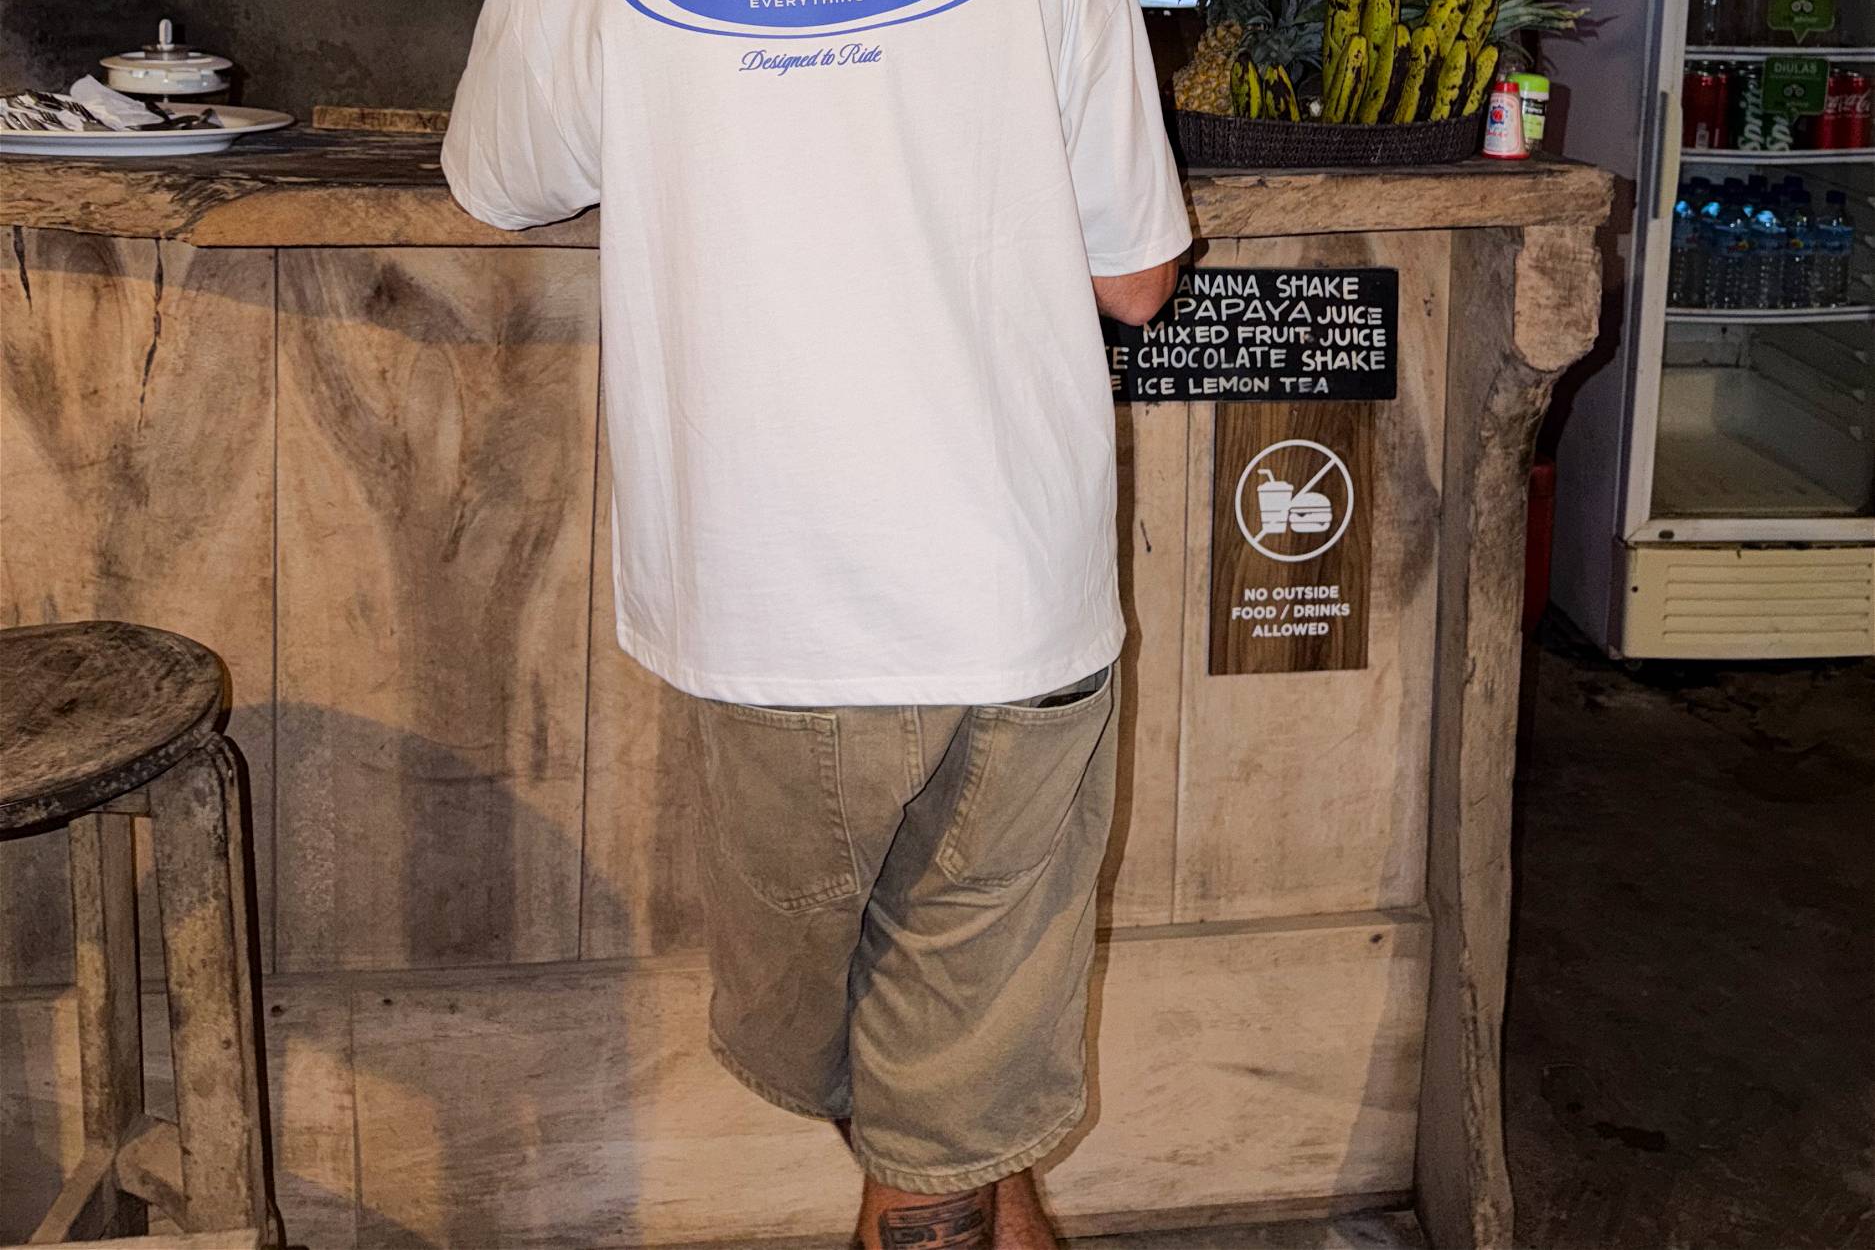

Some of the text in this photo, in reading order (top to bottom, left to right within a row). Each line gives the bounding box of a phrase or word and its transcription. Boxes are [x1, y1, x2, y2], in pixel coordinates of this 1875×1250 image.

[739, 43, 882, 77] Designed to Ride
[1177, 274, 1360, 300] ANANA SHAKE
[1173, 298, 1383, 325] PAPAYA JUICE
[1143, 321, 1387, 348] MIXED FRUIT JUICE
[1137, 346, 1287, 369] CHOCOLATE
[1301, 350, 1386, 371] SHAKE
[1137, 376, 1176, 395] ICE
[1188, 376, 1270, 395] LEMON
[1279, 377, 1330, 395] TEA
[1244, 585, 1339, 601] NO OUTSIDE
[1231, 603, 1351, 621] FOOD / DRINKS
[1251, 622, 1330, 638] ALLOWED
